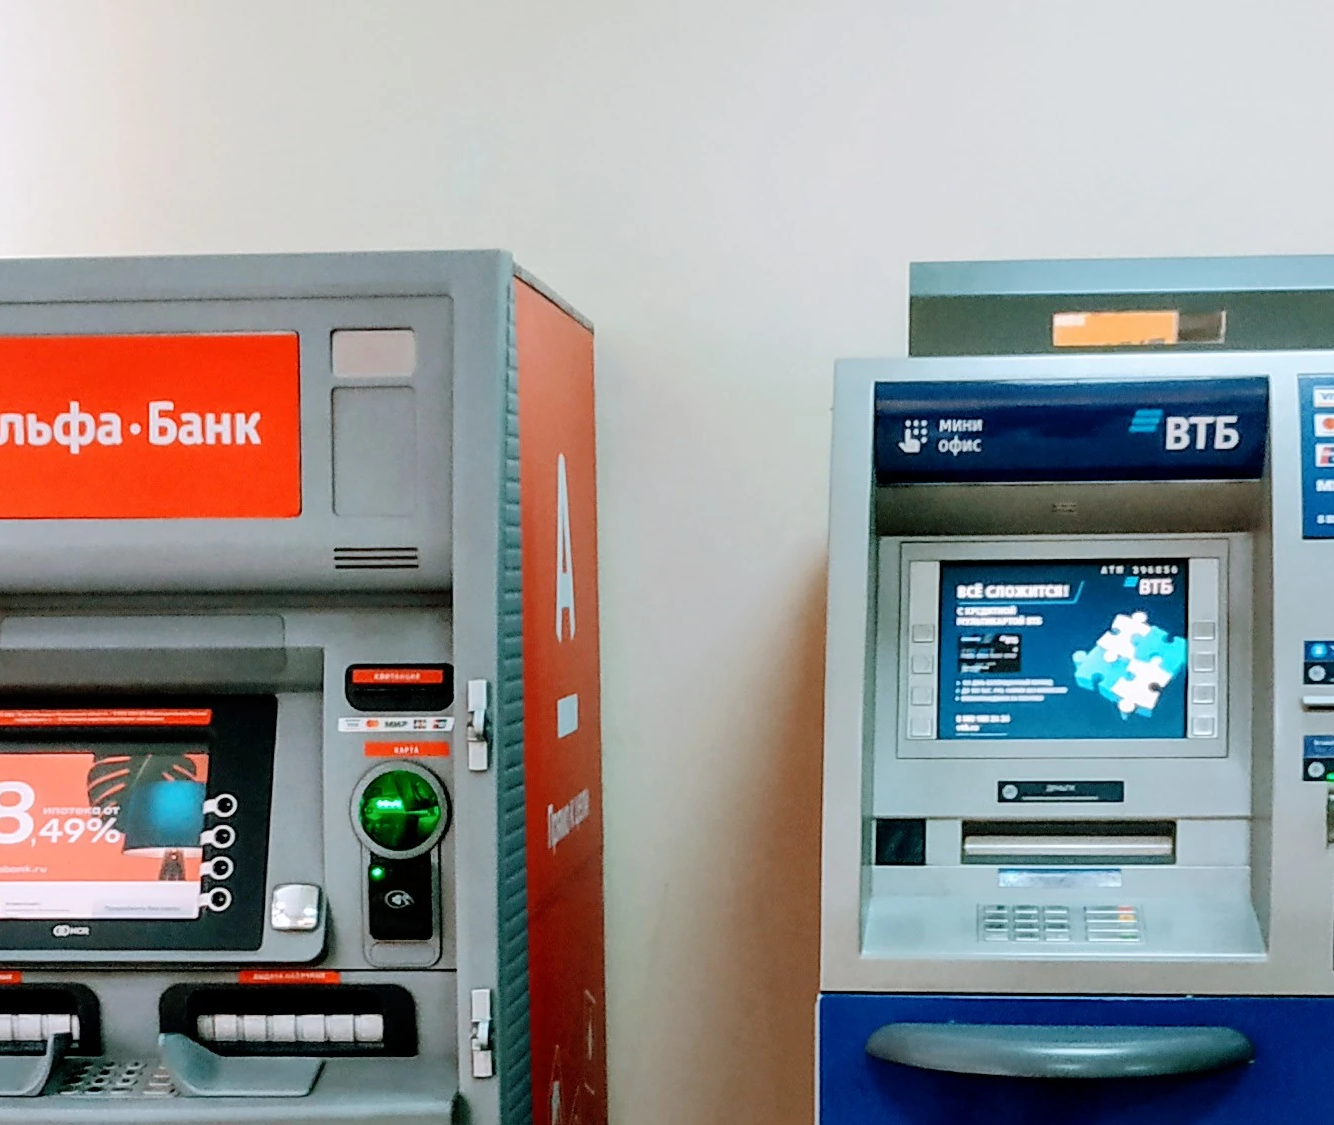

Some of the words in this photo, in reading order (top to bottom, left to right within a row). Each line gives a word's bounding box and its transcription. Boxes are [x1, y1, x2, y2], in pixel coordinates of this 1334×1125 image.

[938, 419, 984, 433] МИНИ
[1165, 415, 1241, 451] ВТБ
[938, 438, 983, 457] офис
[956, 582, 983, 599] ВСЁ
[985, 584, 1070, 598] СЛОЖИТСЯ!
[1139, 578, 1174, 596] ВТБ
[42, 806, 103, 816] ипотека
